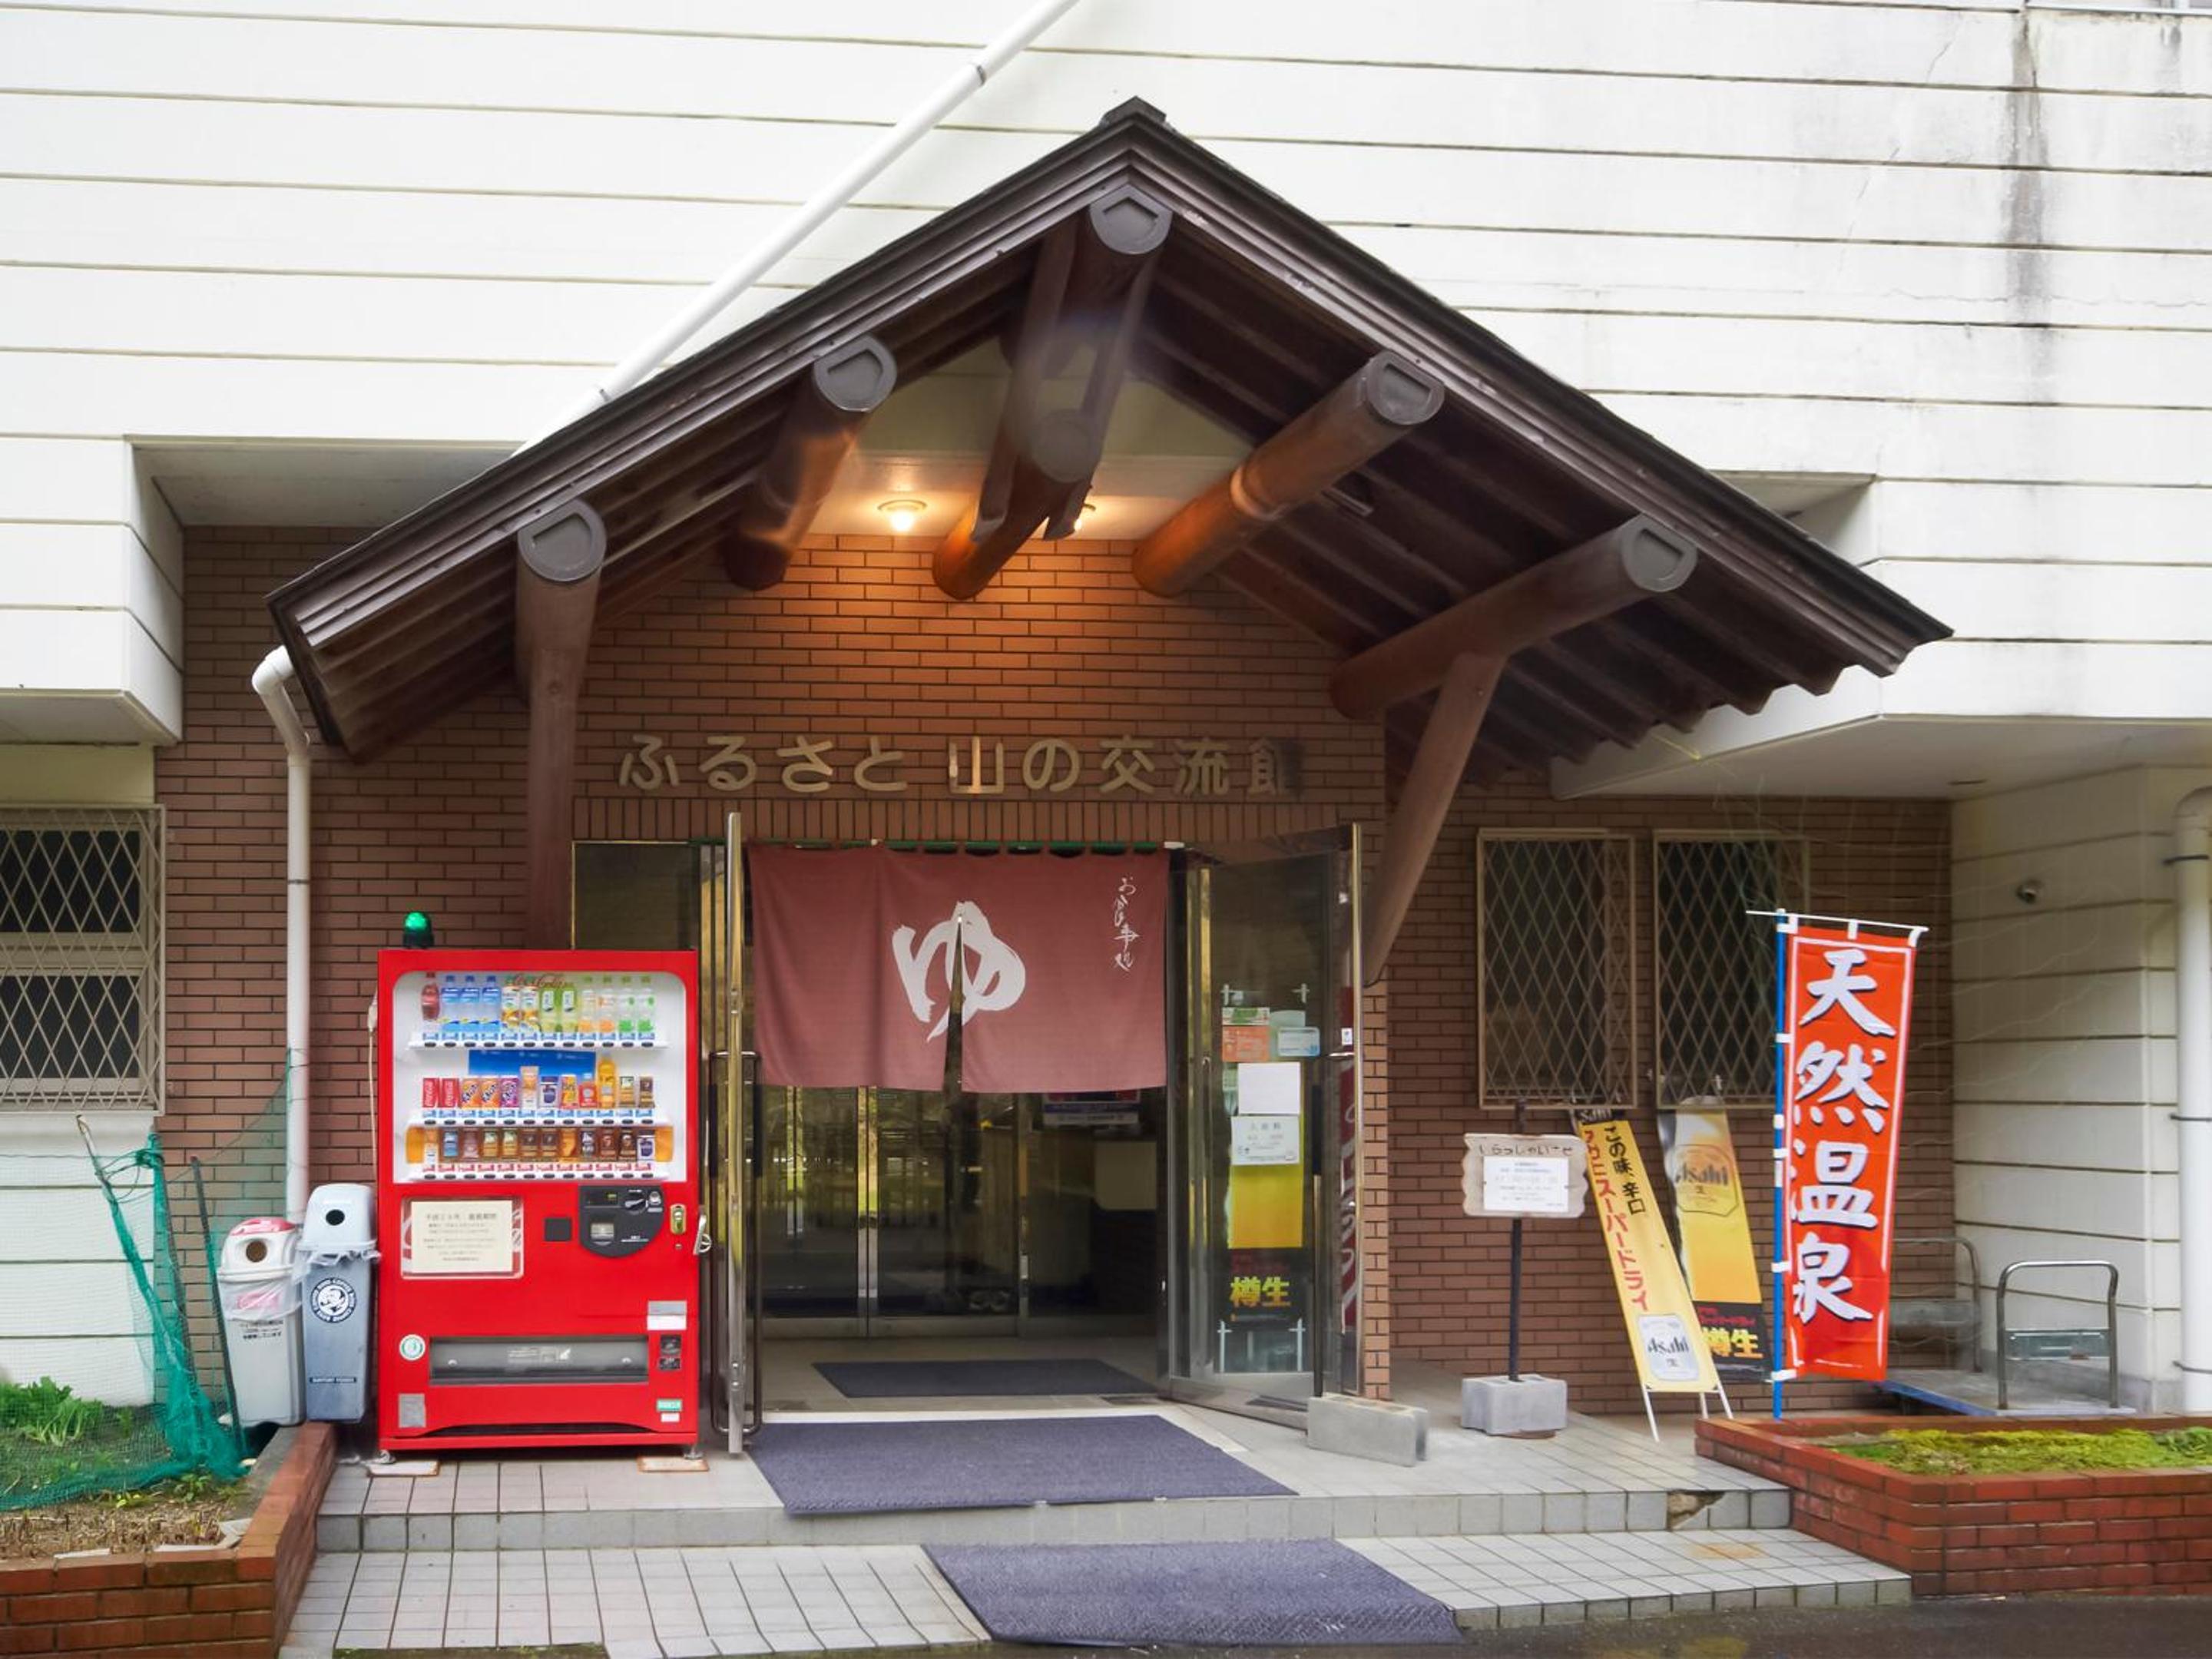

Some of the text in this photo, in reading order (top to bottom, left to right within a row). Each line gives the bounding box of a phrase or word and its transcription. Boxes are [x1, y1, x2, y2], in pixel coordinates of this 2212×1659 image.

[618, 734, 909, 793] ふるさと
[892, 901, 1026, 1042] ゆ
[1790, 948, 1896, 1324] 天然温泉
[1230, 1276, 1291, 1308] 樽生
[1647, 1336, 1690, 1355] Asahi
